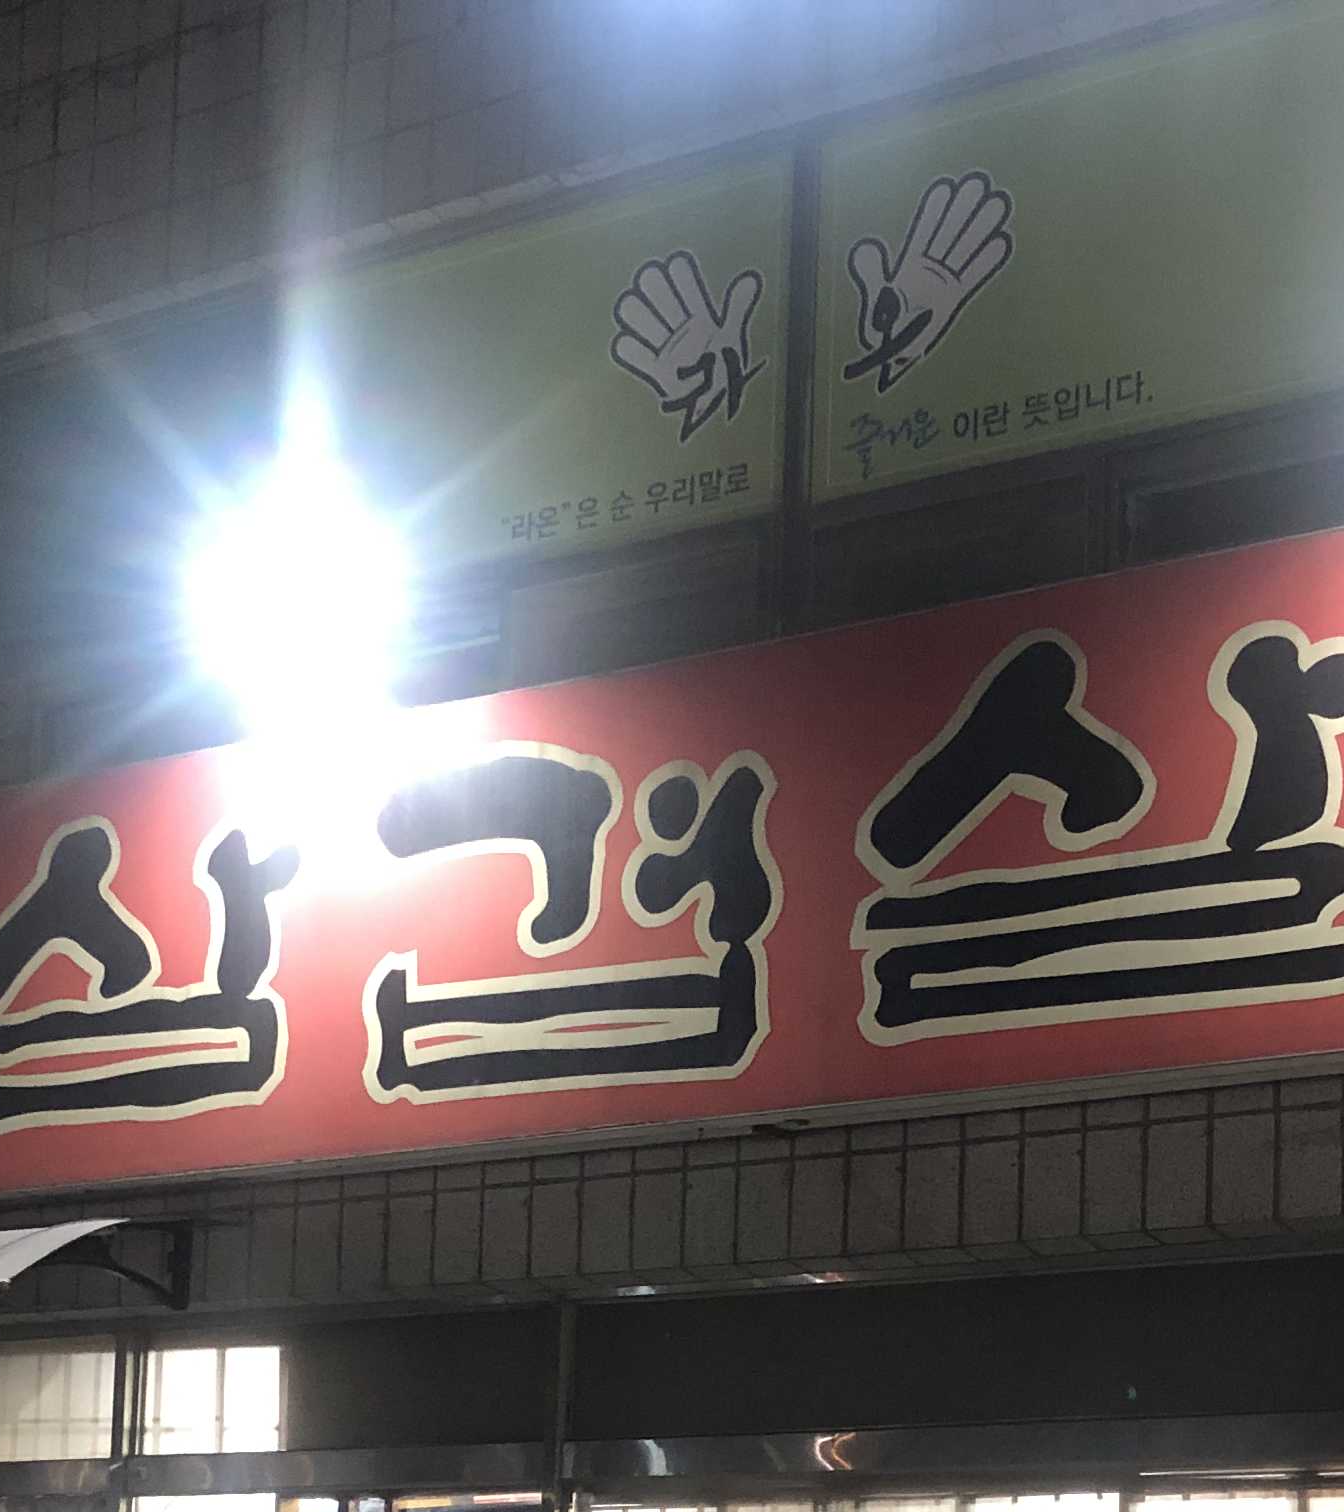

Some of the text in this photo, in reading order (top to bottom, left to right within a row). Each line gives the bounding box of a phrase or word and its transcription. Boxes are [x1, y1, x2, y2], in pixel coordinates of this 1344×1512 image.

[953, 402, 1010, 441] 이란
[1021, 370, 1154, 430] 뜻입니다.
[611, 489, 635, 523] 순
[645, 462, 750, 513] 우리말로
